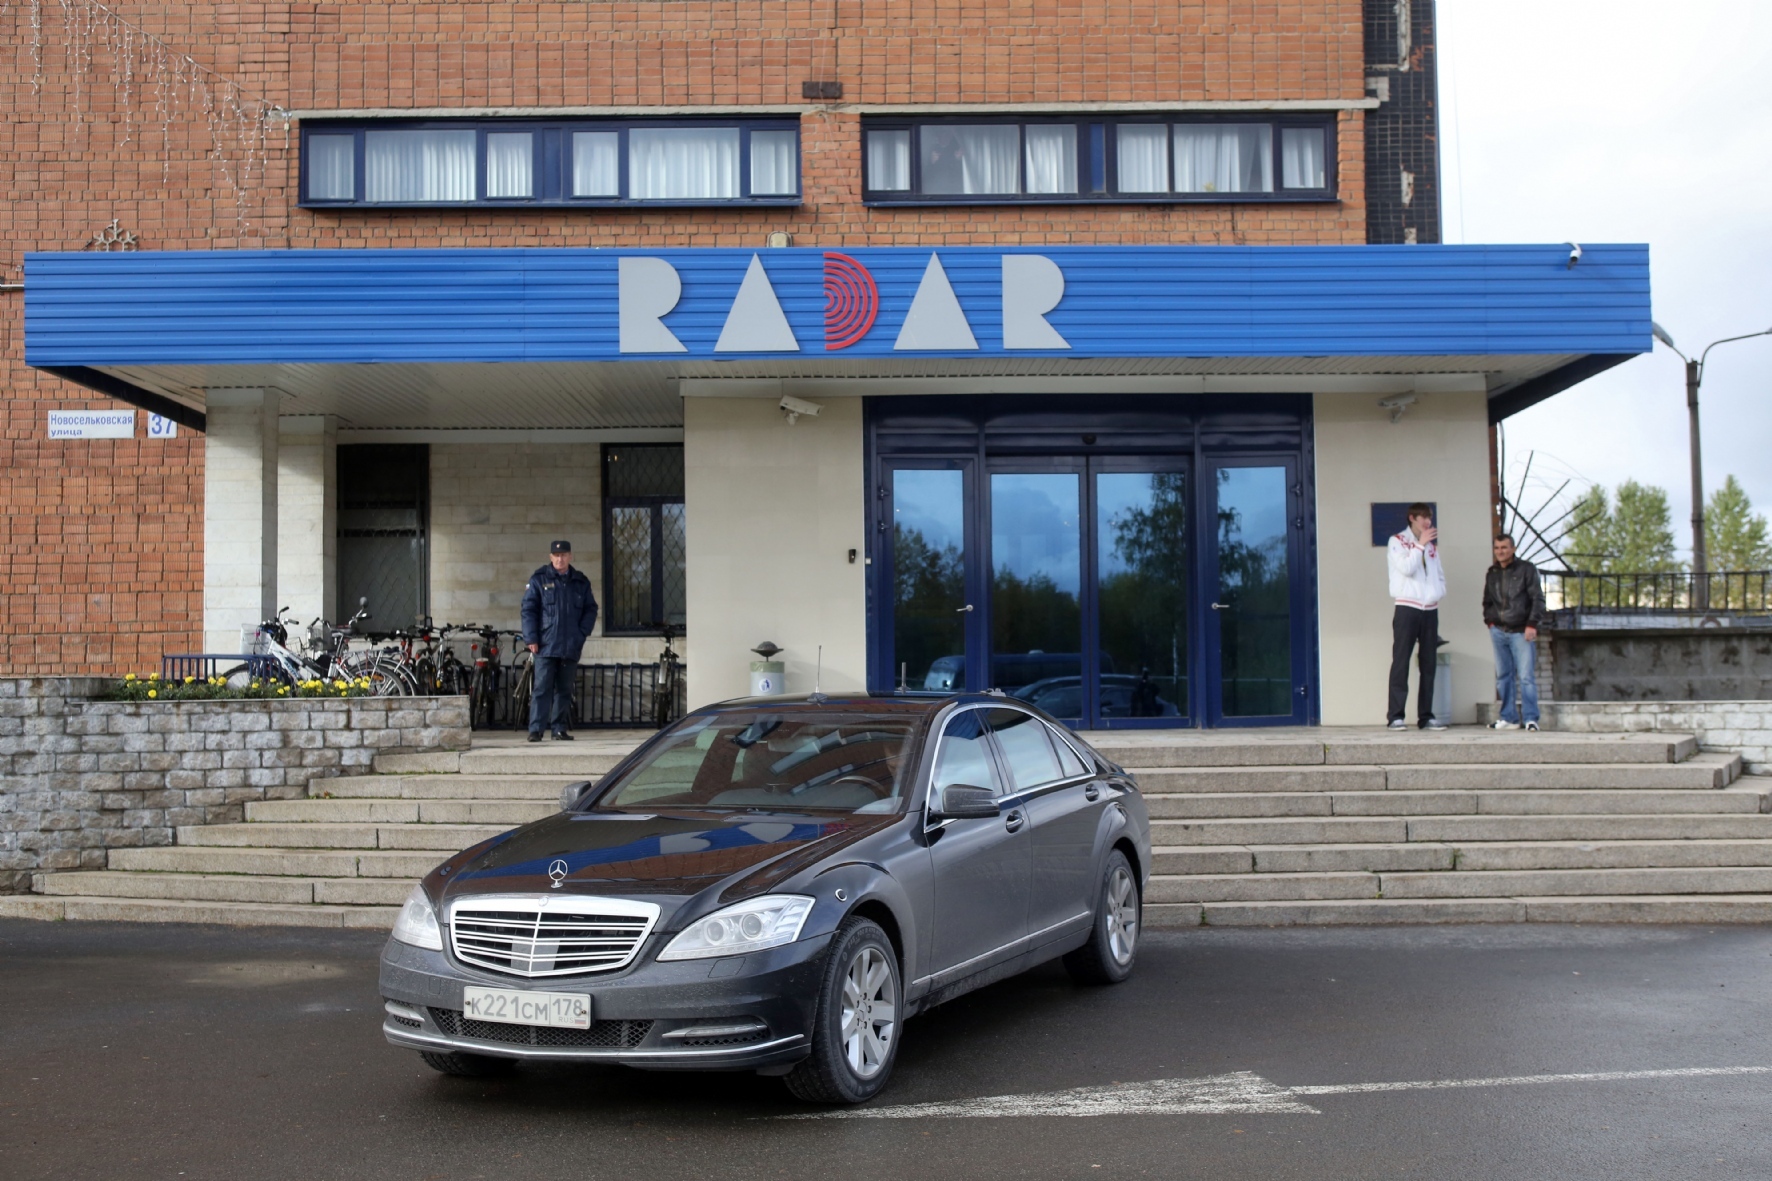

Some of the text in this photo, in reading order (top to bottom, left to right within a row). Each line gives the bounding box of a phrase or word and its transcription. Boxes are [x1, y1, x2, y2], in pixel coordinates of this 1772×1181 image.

[618, 250, 1073, 354] RADAR
[50, 414, 133, 426] Новосельковская
[50, 428, 83, 437] улица
[552, 998, 583, 1017] 178
[558, 1016, 574, 1024] RUS
